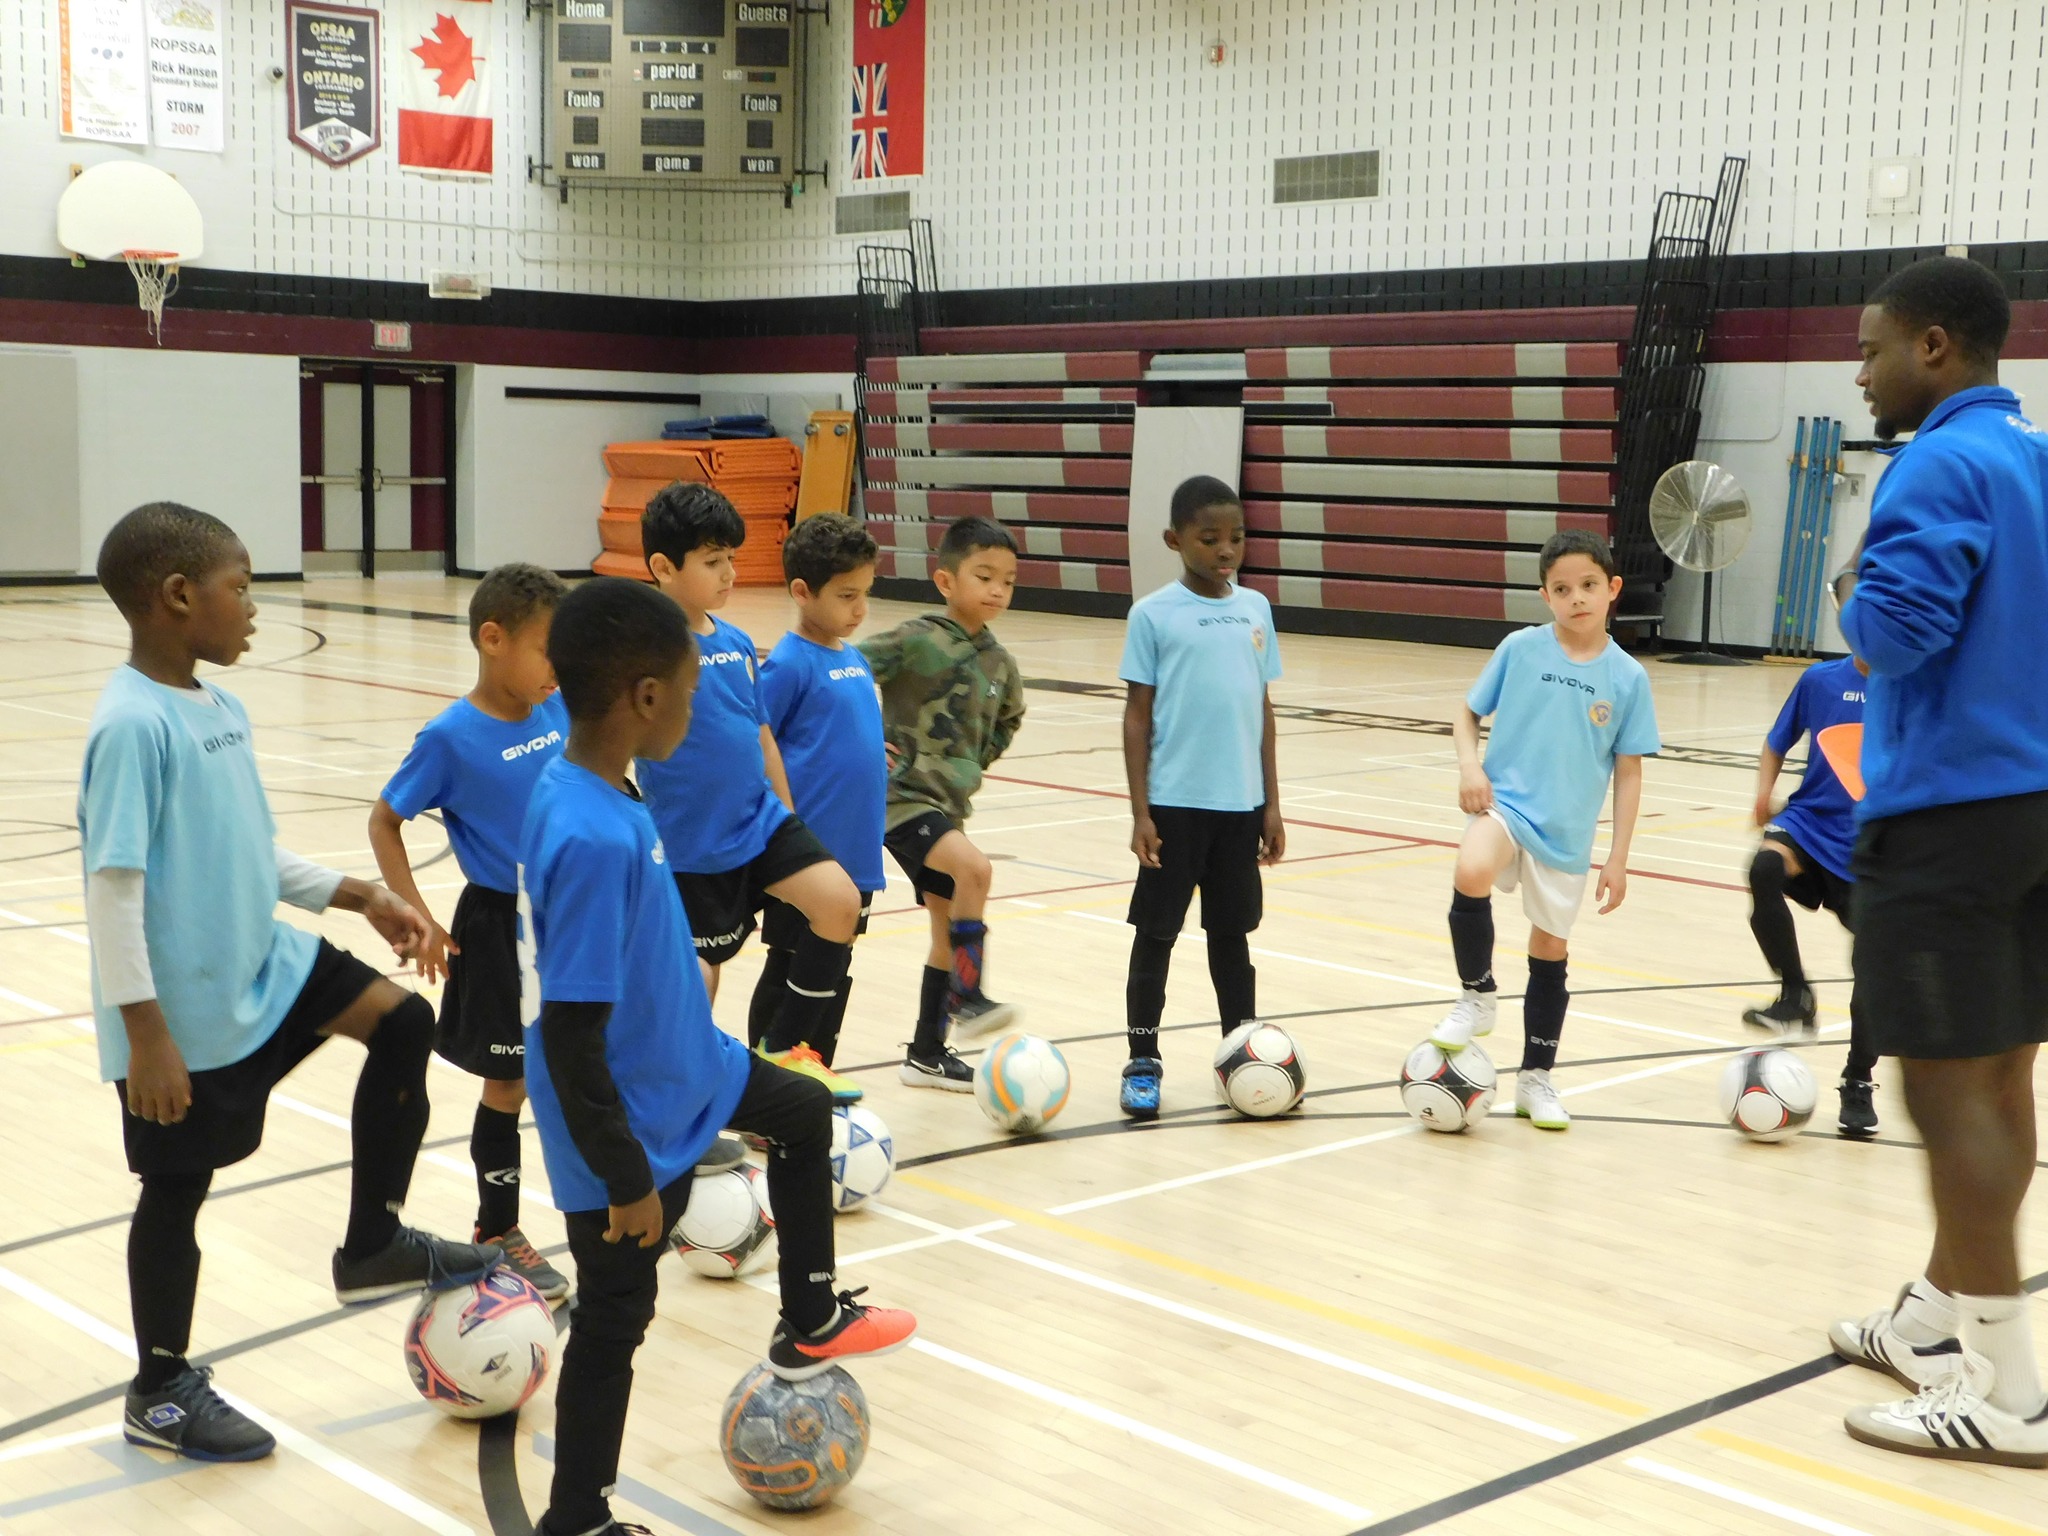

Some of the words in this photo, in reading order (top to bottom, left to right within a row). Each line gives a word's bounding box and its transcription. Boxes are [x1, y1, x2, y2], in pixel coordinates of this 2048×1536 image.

[565, 0, 605, 18] Home
[738, 3, 788, 22] Guests
[309, 22, 356, 41] OFSAA
[150, 37, 217, 56] ROPSSAA
[639, 41, 644, 53] 1
[660, 41, 668, 54] 2
[680, 42, 688, 54] 3
[701, 42, 710, 55] 4
[151, 60, 175, 74] Rick
[178, 62, 218, 79] Hansen
[650, 62, 697, 81] period
[151, 74, 190, 88] Secondary
[192, 79, 219, 90] School
[303, 71, 365, 91] ONTARIO
[166, 99, 205, 115] STORM
[567, 90, 601, 108] fouls
[650, 91, 696, 111] player
[744, 95, 778, 112] fouls
[171, 121, 201, 136] 2007
[571, 154, 600, 168] won
[655, 156, 691, 173] game
[746, 158, 775, 173] won
[1197, 615, 1252, 627] GIVOVA
[1541, 673, 1596, 696] GIVOVA
[501, 730, 561, 762] GIVOVA
